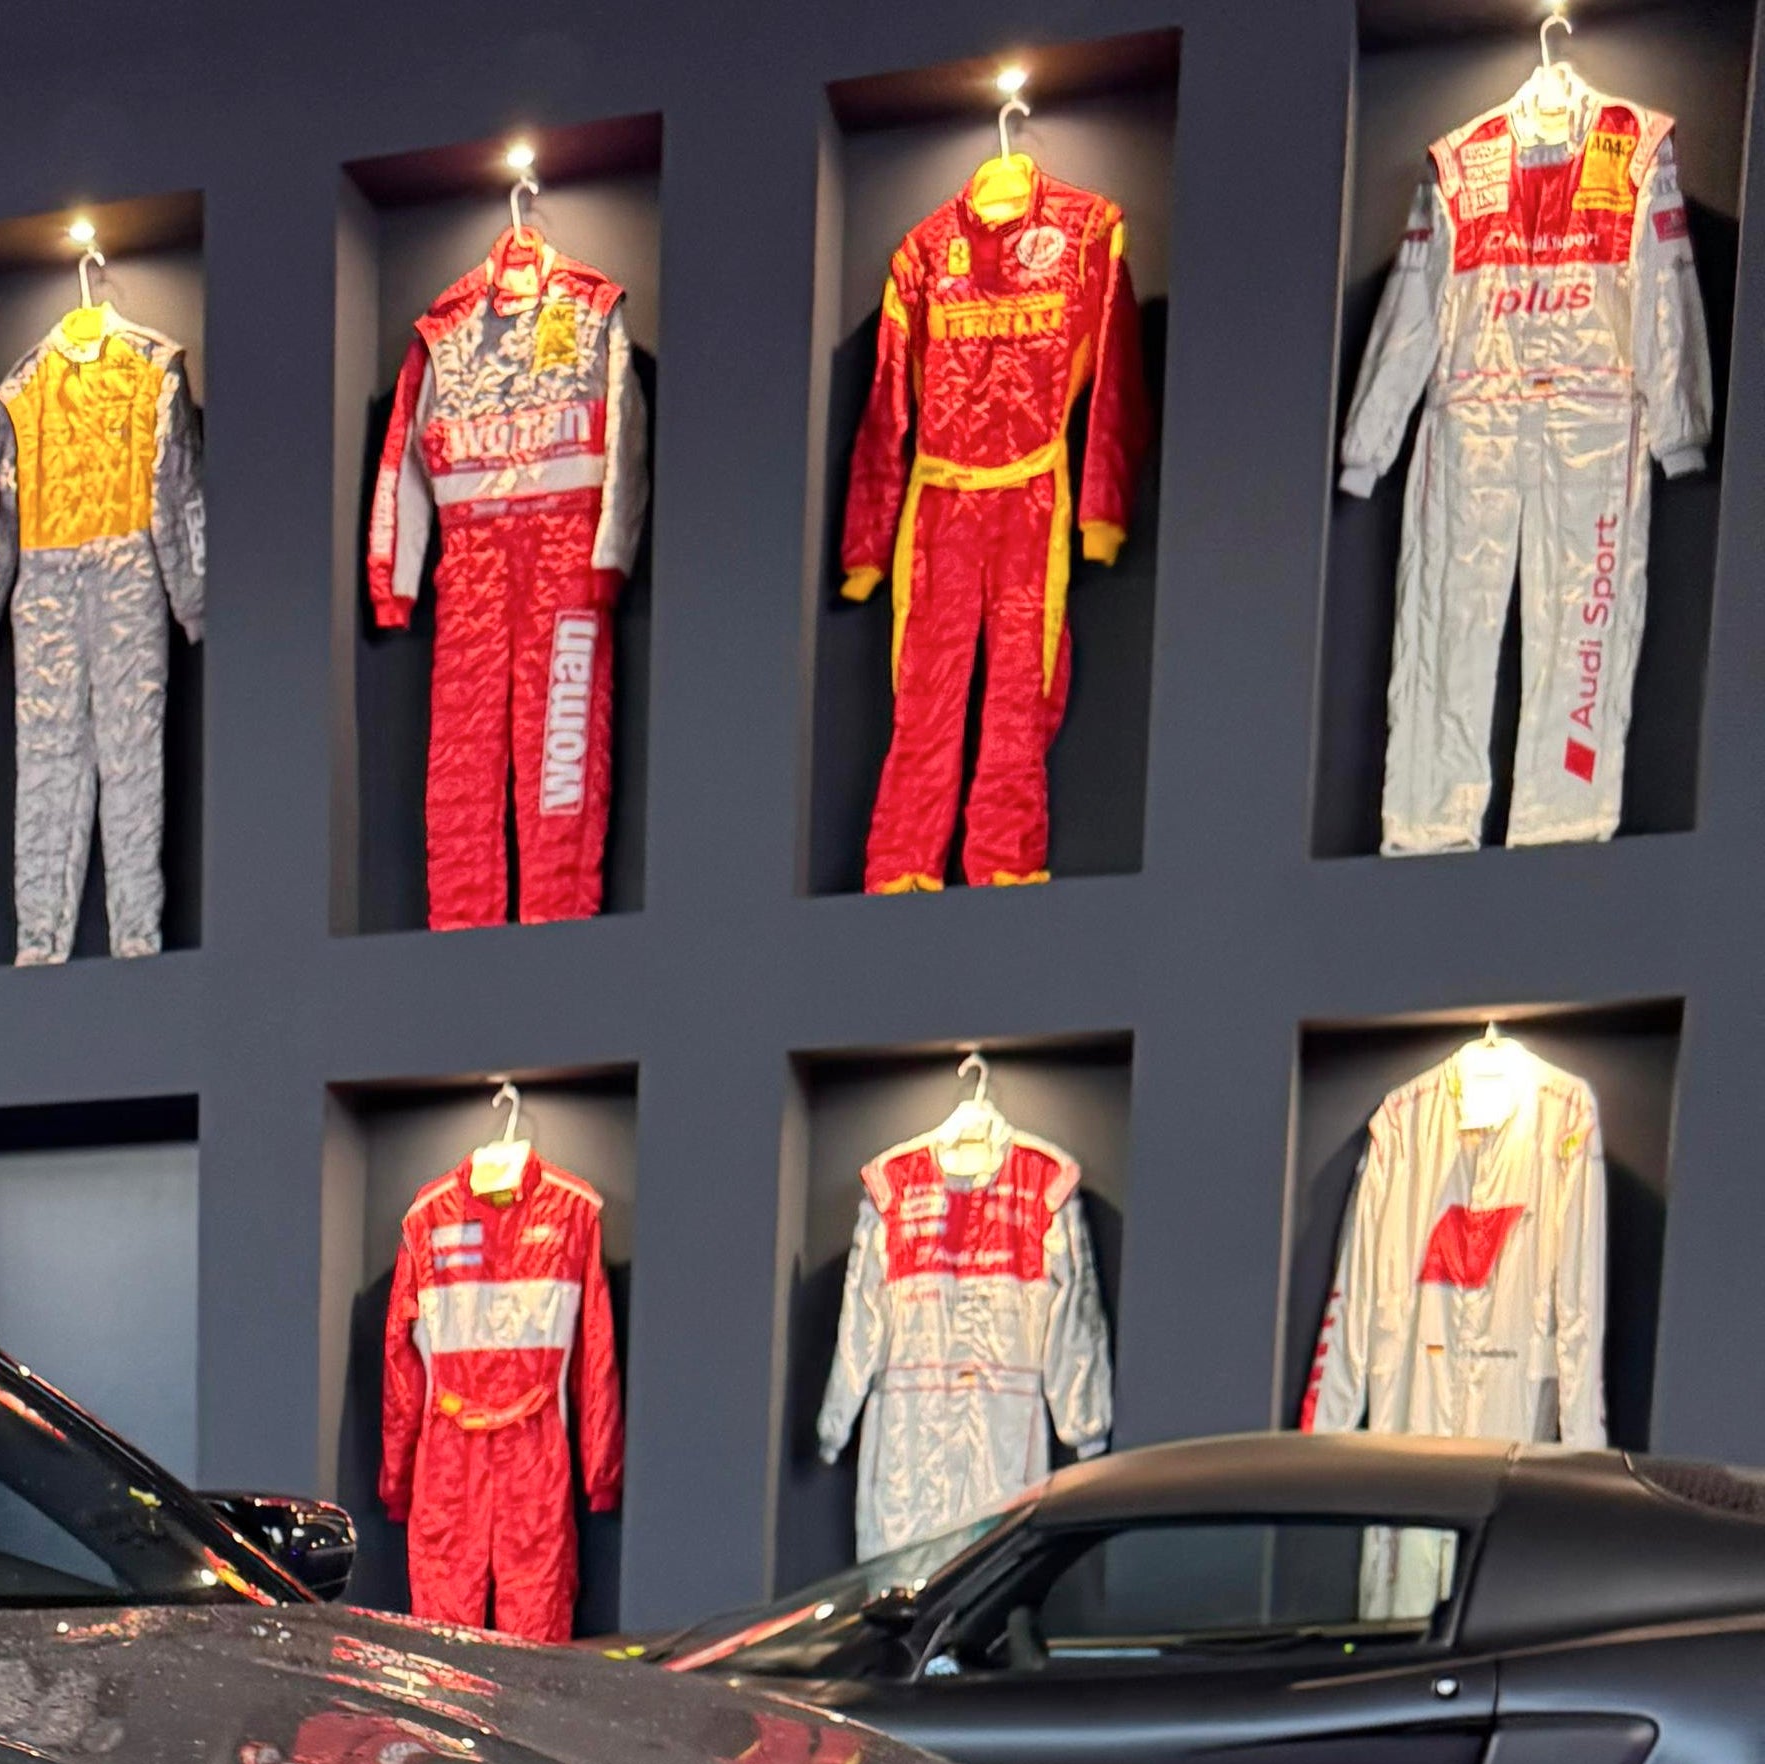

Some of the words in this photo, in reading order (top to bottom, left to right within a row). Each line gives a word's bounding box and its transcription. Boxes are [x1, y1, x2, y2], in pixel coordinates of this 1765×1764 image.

[1491, 280, 1592, 322] plus
[1583, 512, 1619, 629] Sport
[542, 618, 598, 810] woman
[1570, 639, 1604, 731] Audi
